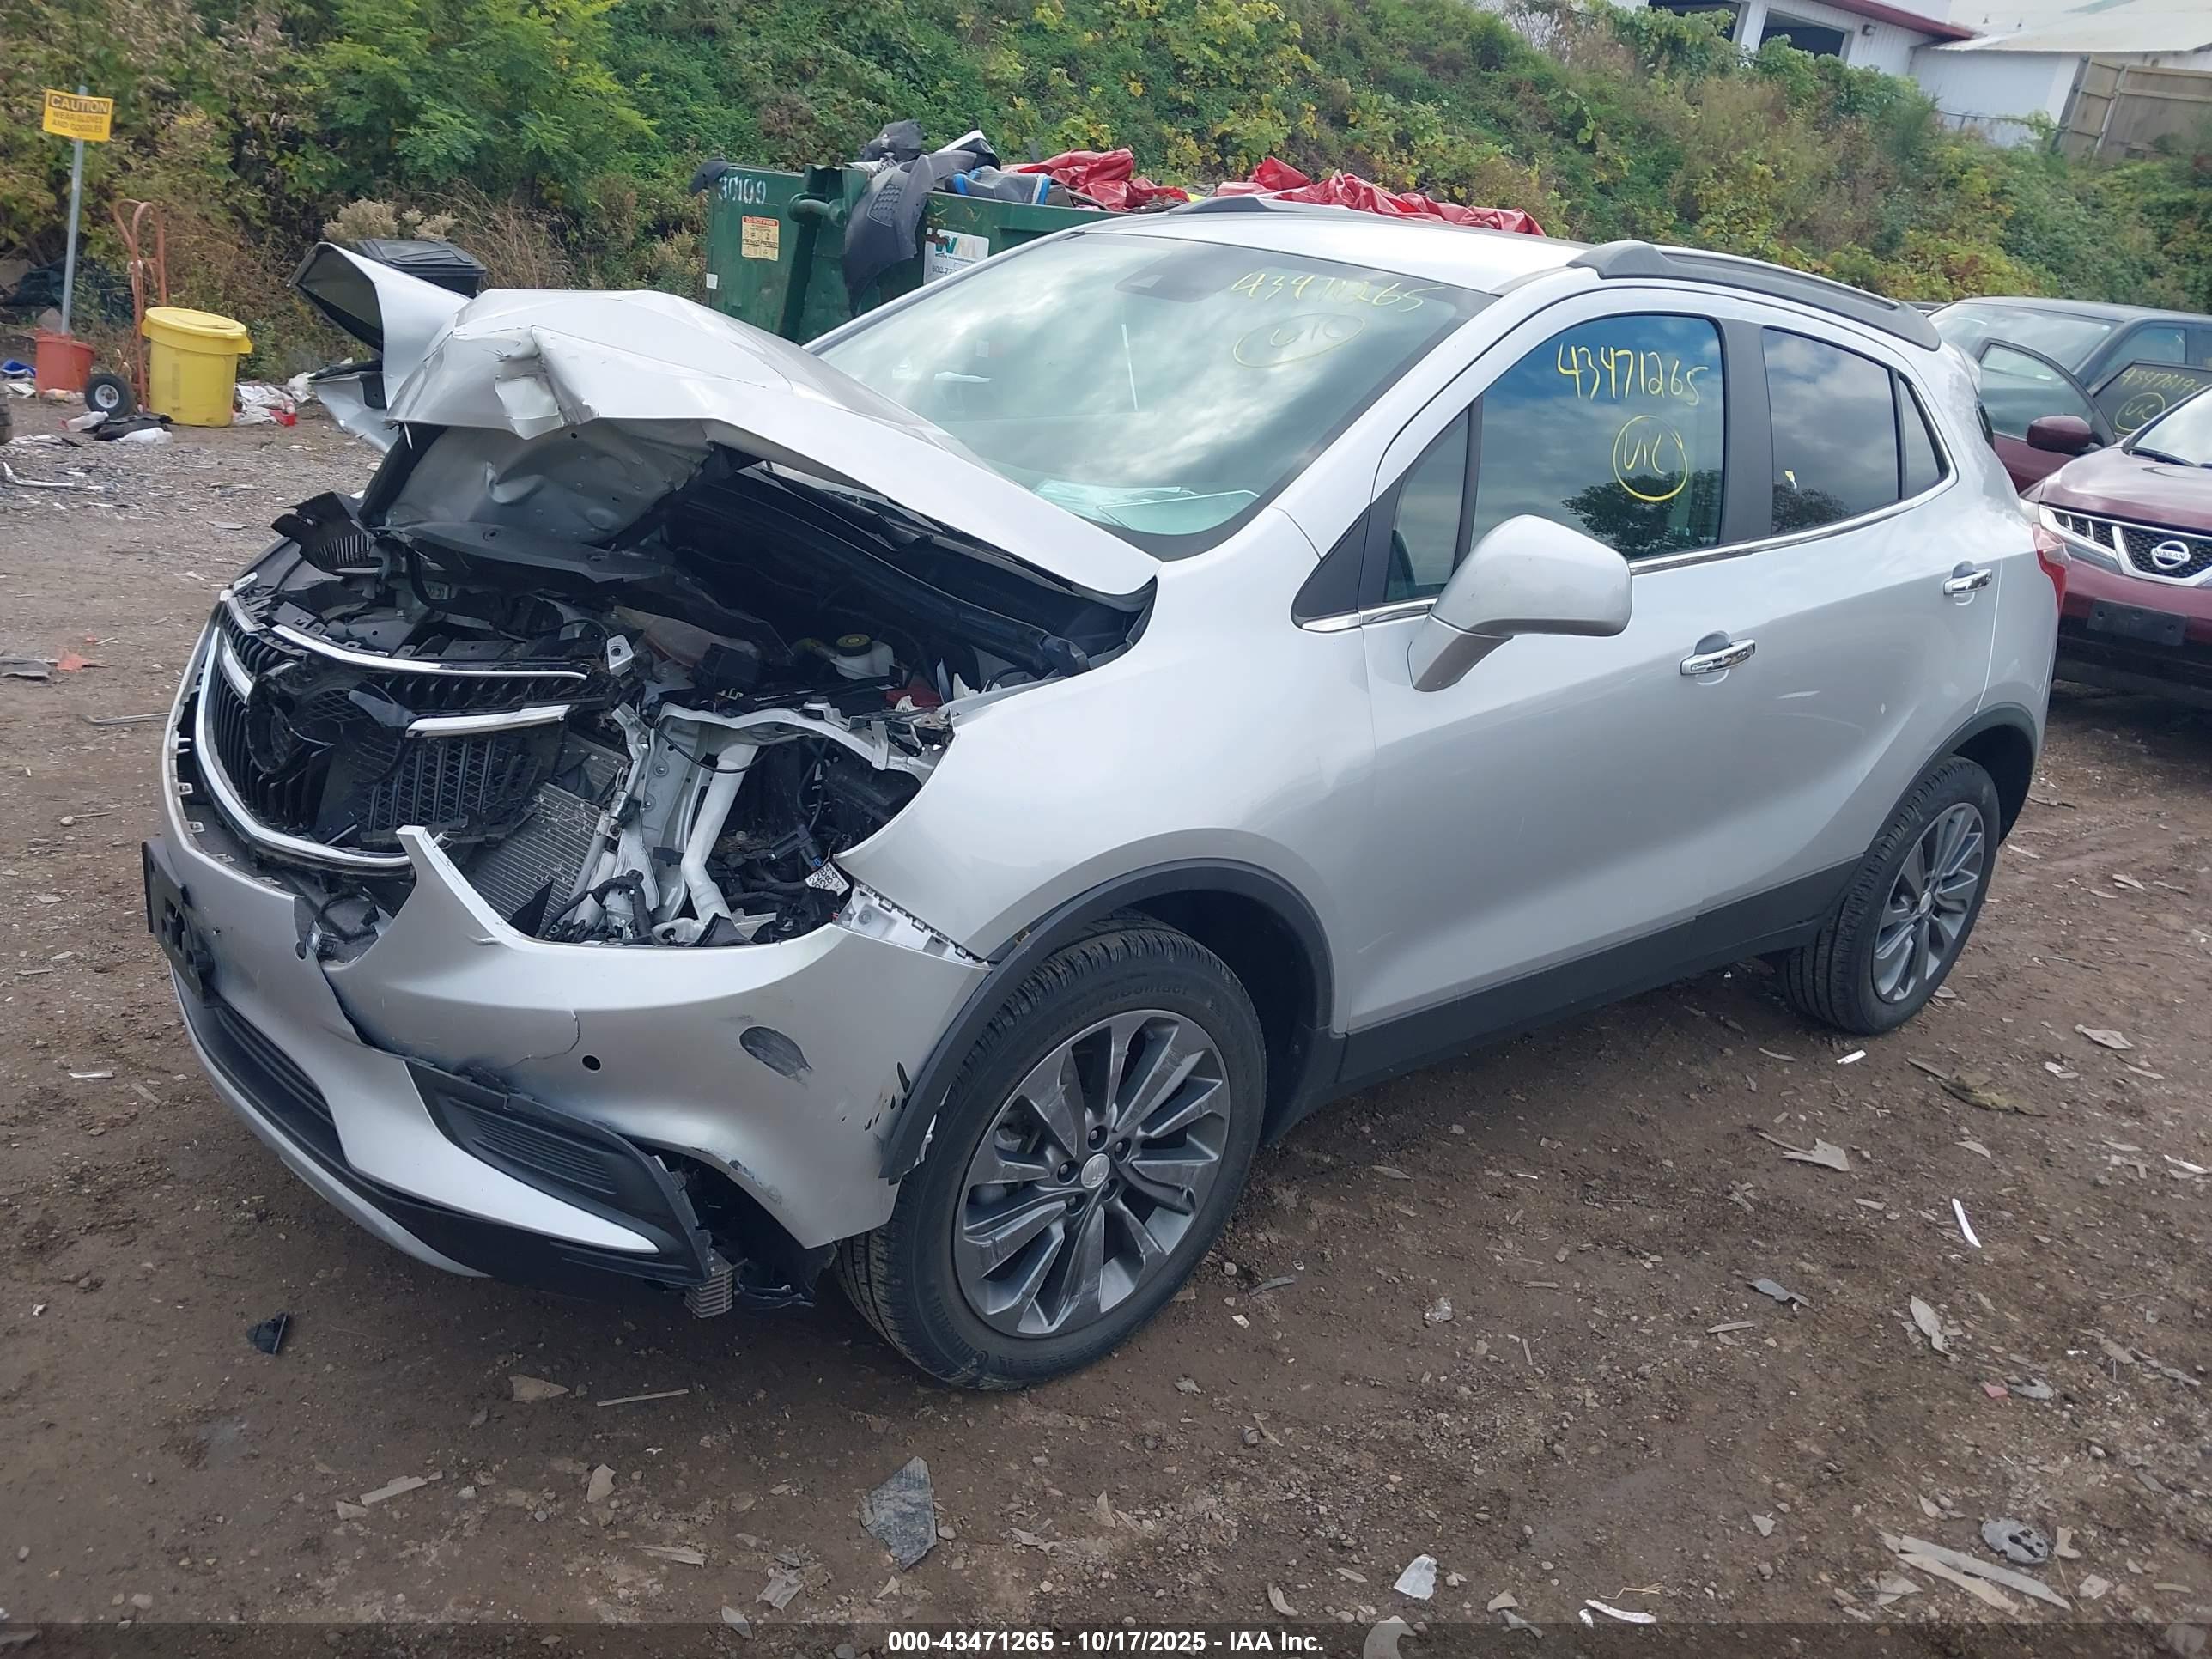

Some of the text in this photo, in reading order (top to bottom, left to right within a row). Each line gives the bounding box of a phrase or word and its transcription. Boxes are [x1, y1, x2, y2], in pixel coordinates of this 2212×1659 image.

[51, 95, 108, 112] CAUTION
[52, 119, 69, 128] AND
[53, 110, 75, 121] WEAR
[1229, 272, 1446, 313] 43471265
[1556, 343, 1709, 406] 43471265
